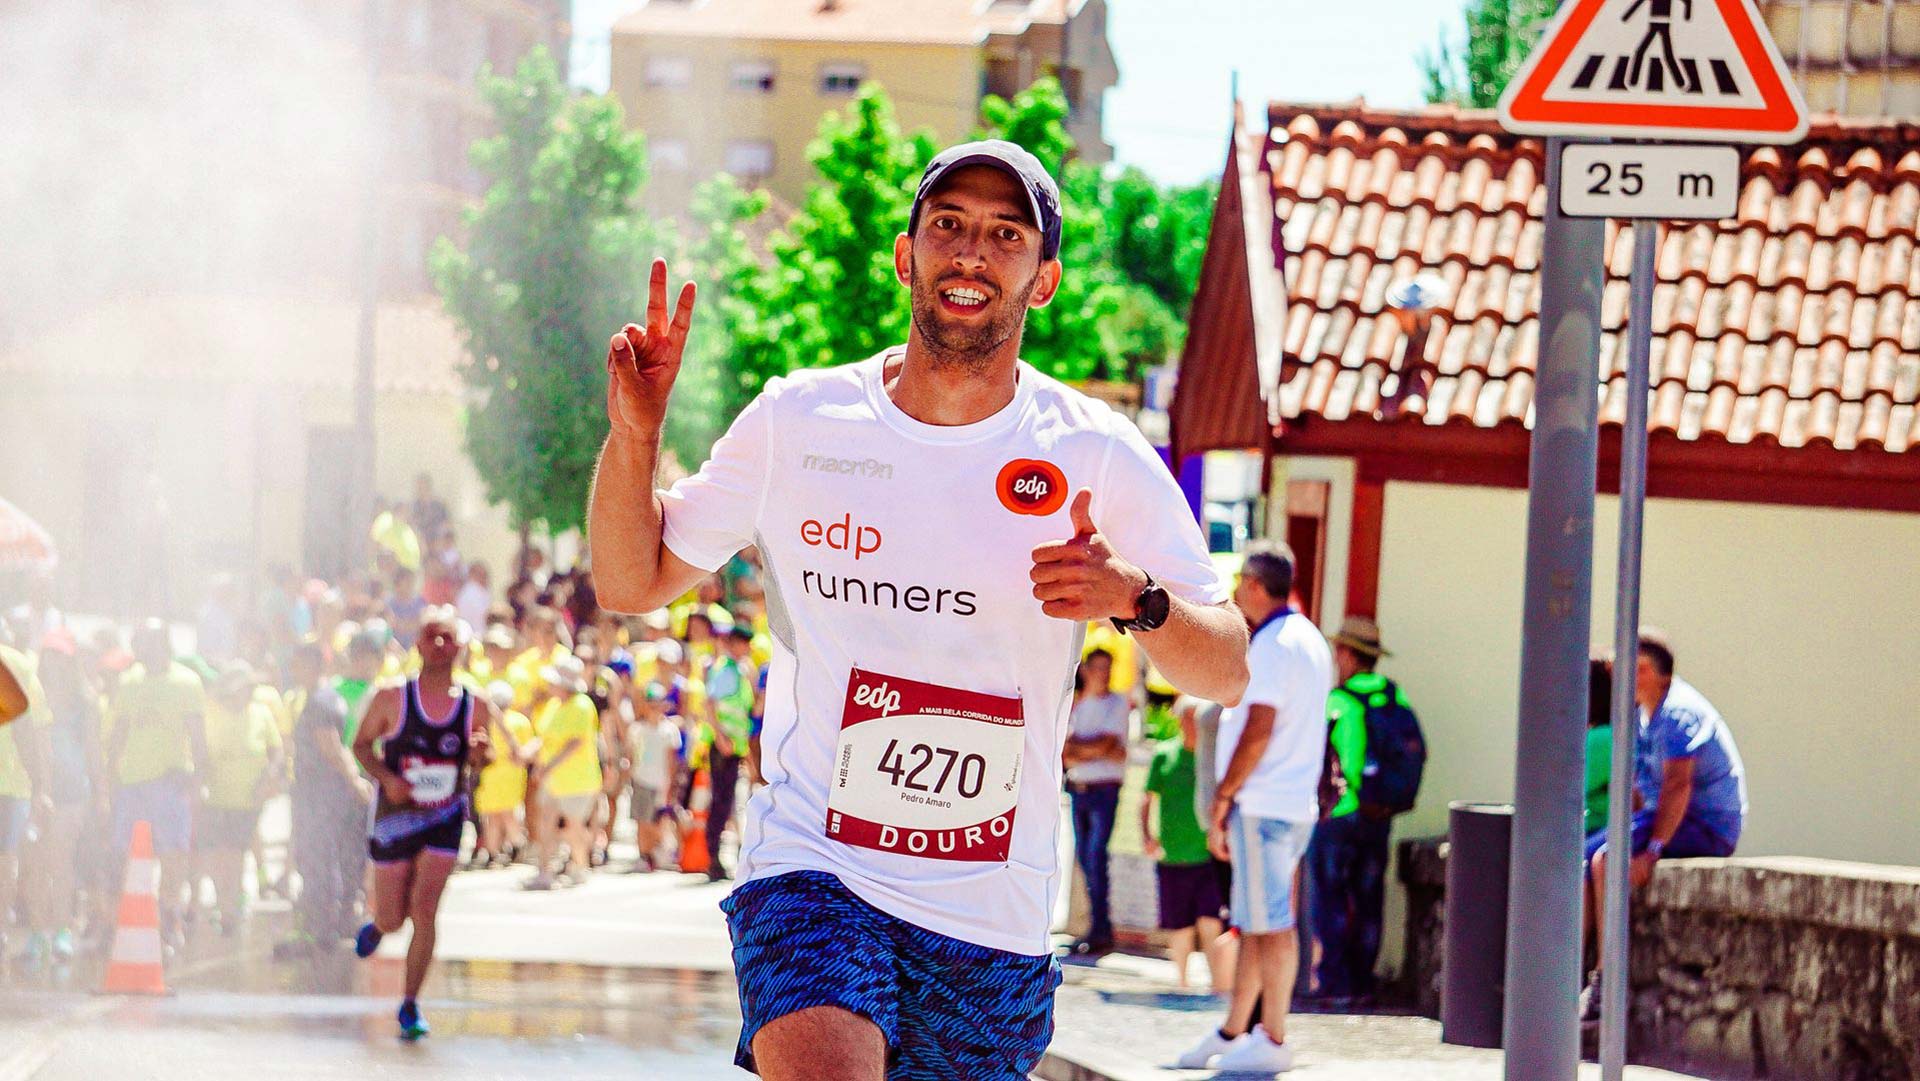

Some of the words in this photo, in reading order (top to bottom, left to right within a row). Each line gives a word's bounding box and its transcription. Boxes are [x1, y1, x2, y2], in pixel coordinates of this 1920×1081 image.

[1586, 162, 1643, 196] 25
[1678, 172, 1713, 197] m
[1013, 475, 1048, 500] edp
[800, 512, 882, 561] edp
[802, 569, 977, 616] runners
[853, 681, 901, 717] edp
[925, 707, 942, 715] MAIS
[943, 708, 962, 717] BELA
[962, 710, 992, 722] CORRIDA
[993, 716, 1004, 724] DO
[877, 738, 986, 799] 4270
[900, 792, 925, 804] Pedro
[925, 797, 952, 809] Amaro
[878, 815, 1010, 853] DOURO
